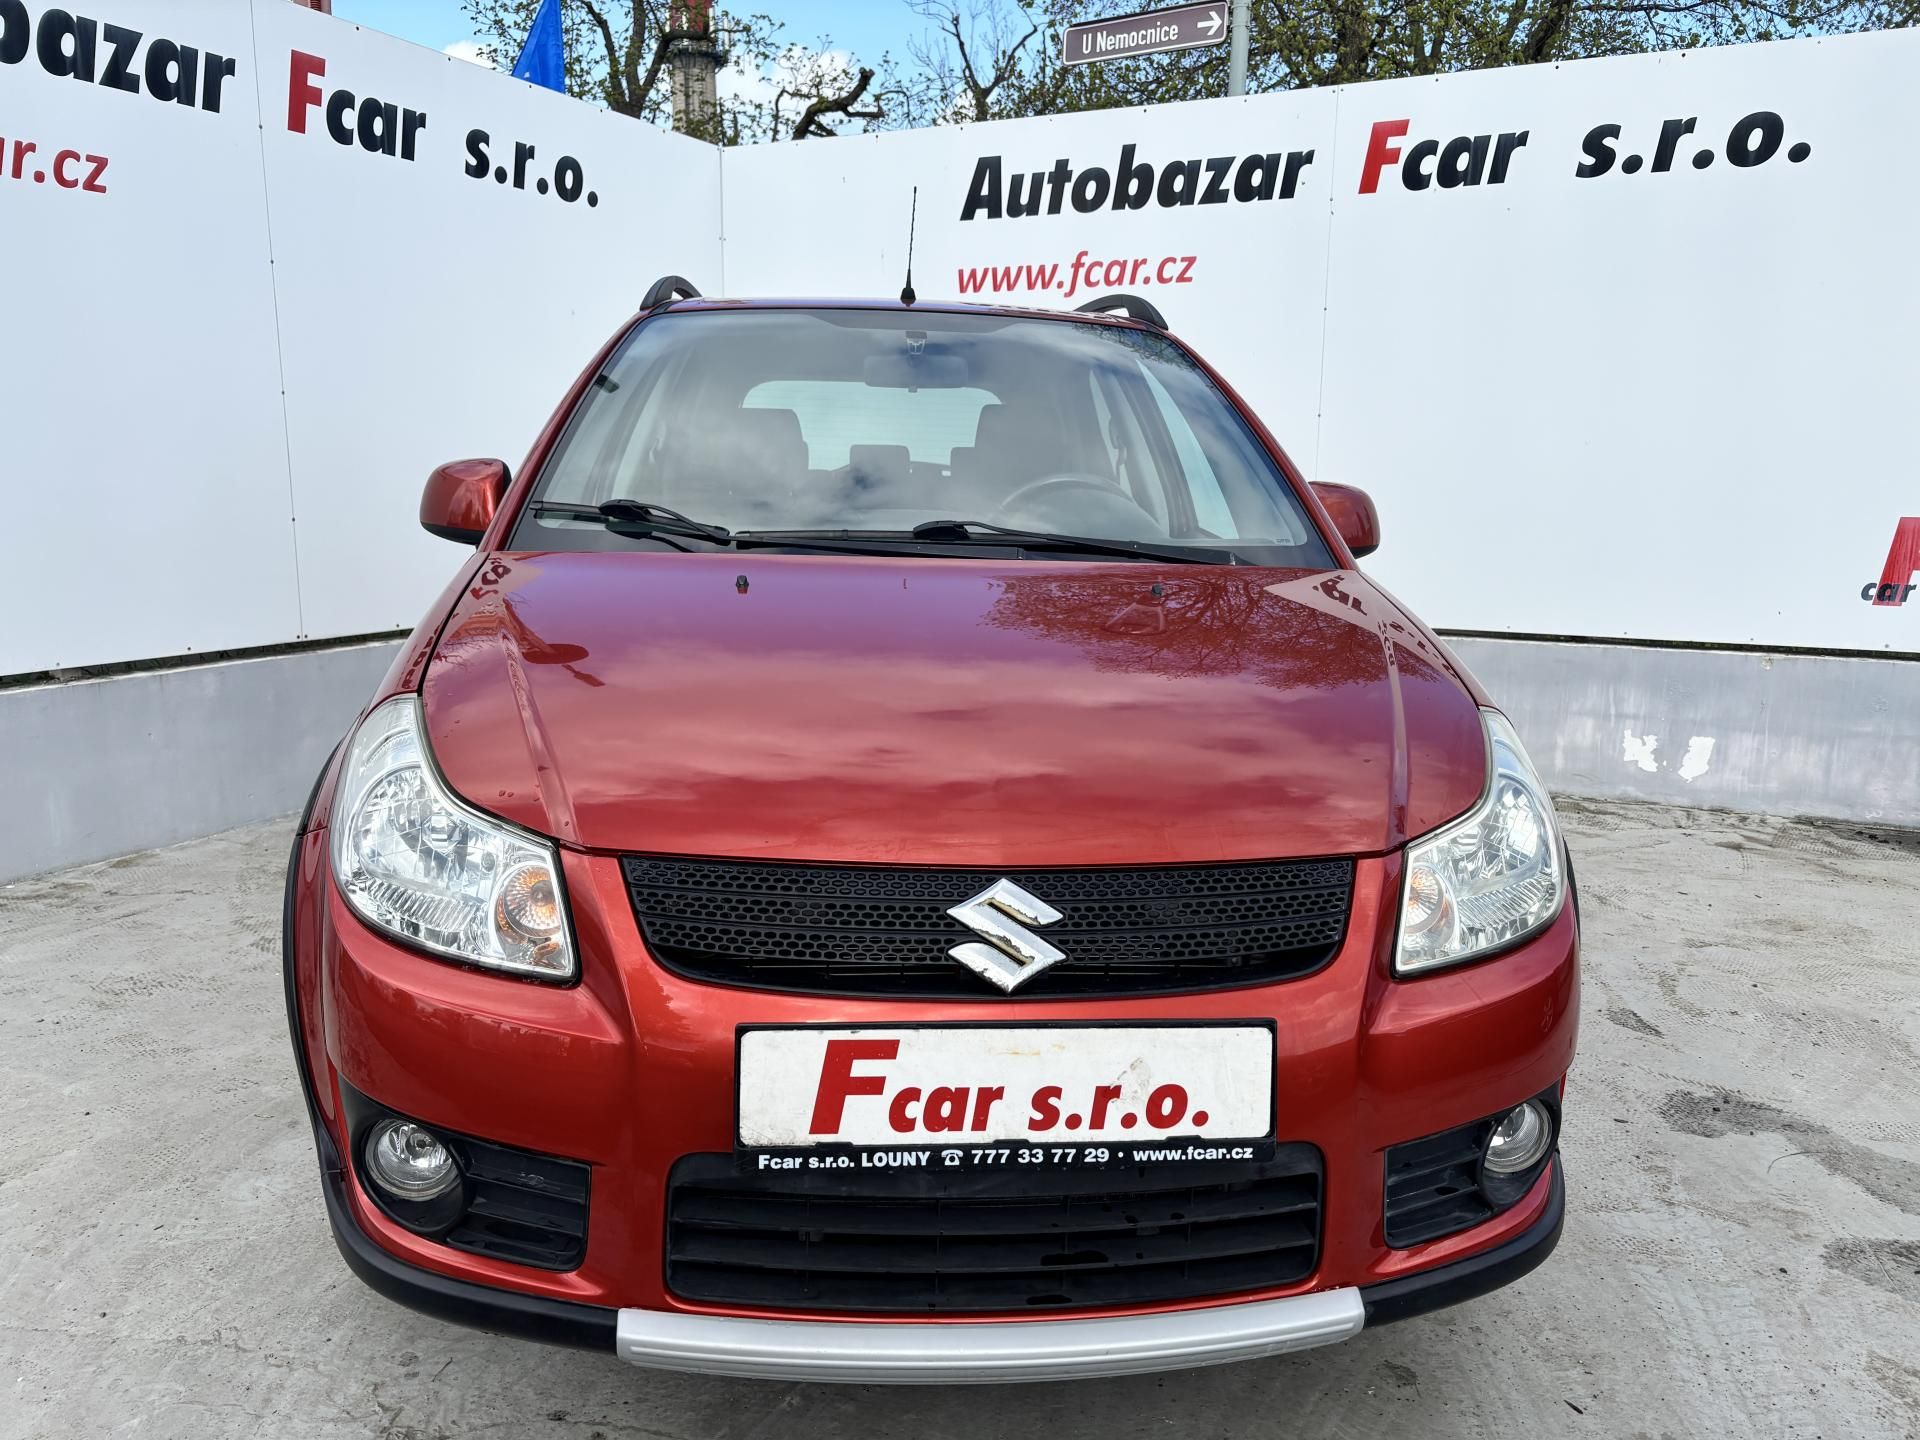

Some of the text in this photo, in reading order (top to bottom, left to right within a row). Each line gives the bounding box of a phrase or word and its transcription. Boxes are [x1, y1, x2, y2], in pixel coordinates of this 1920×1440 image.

[1082, 22, 1179, 54] U Nemocnice
[288, 50, 426, 161] Fcar
[465, 129, 598, 207] s.r.o.
[0, 137, 109, 194] r.cz
[960, 112, 1811, 221] Autobazar Fcar s.r.o.
[958, 251, 1197, 298] www.fcar.cz
[809, 1039, 1208, 1135] Fcar s.r.o.
[758, 1145, 1254, 1170] Fcar s.r.o. LOUNY 777 33 77 29 www.fcar.cz
